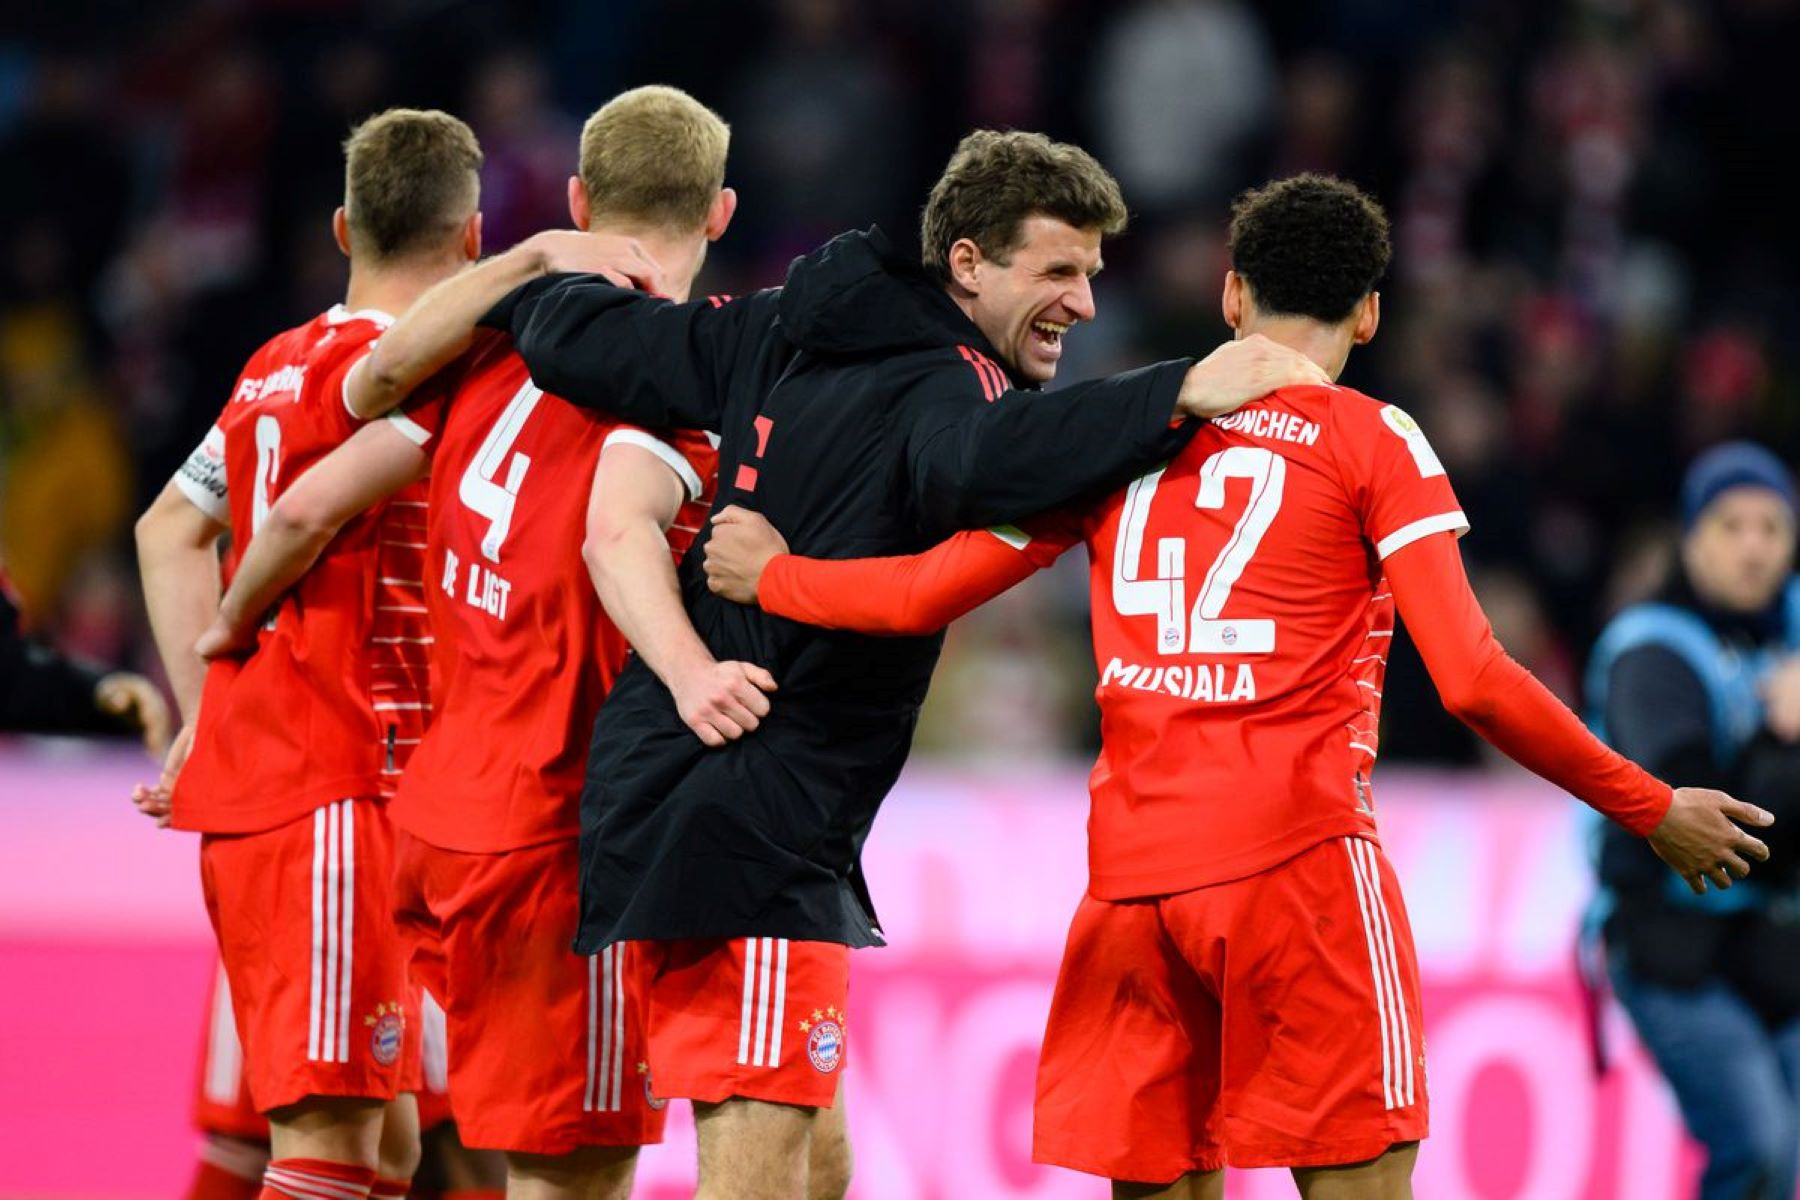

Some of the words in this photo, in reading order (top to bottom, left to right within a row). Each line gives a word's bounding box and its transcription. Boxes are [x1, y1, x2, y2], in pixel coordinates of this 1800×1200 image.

[459, 379, 544, 563] 4
[466, 563, 511, 622] LIGT
[1112, 446, 1286, 654] 42
[1101, 657, 1256, 702] MUSIALA
